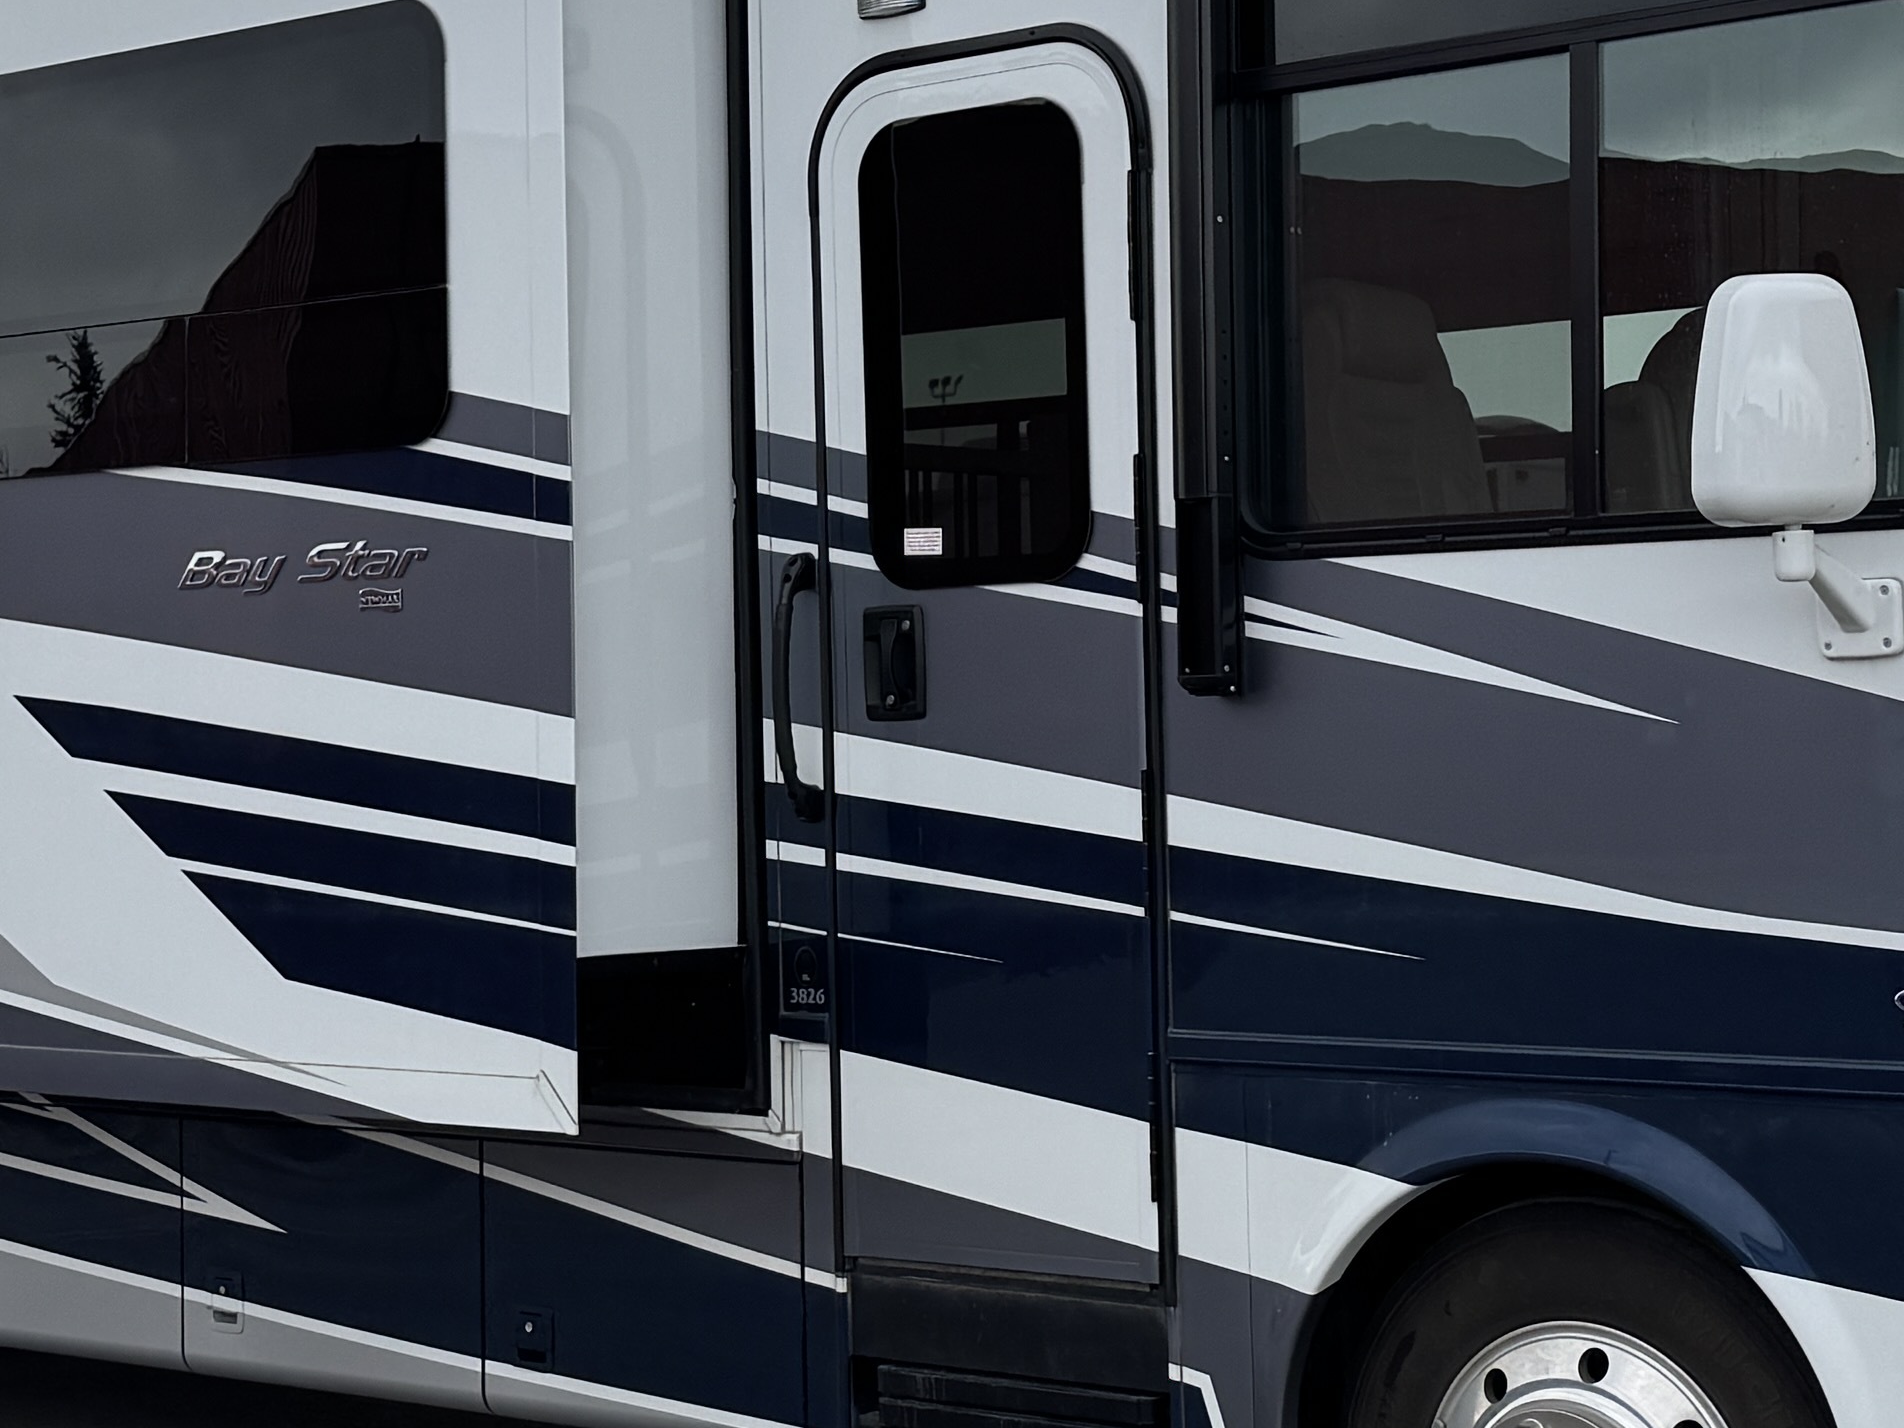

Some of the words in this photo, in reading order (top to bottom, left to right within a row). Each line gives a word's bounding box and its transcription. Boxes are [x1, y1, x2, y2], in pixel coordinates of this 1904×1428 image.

[177, 549, 289, 598] Bay
[296, 539, 429, 585] Star
[789, 987, 825, 1005] 3826
